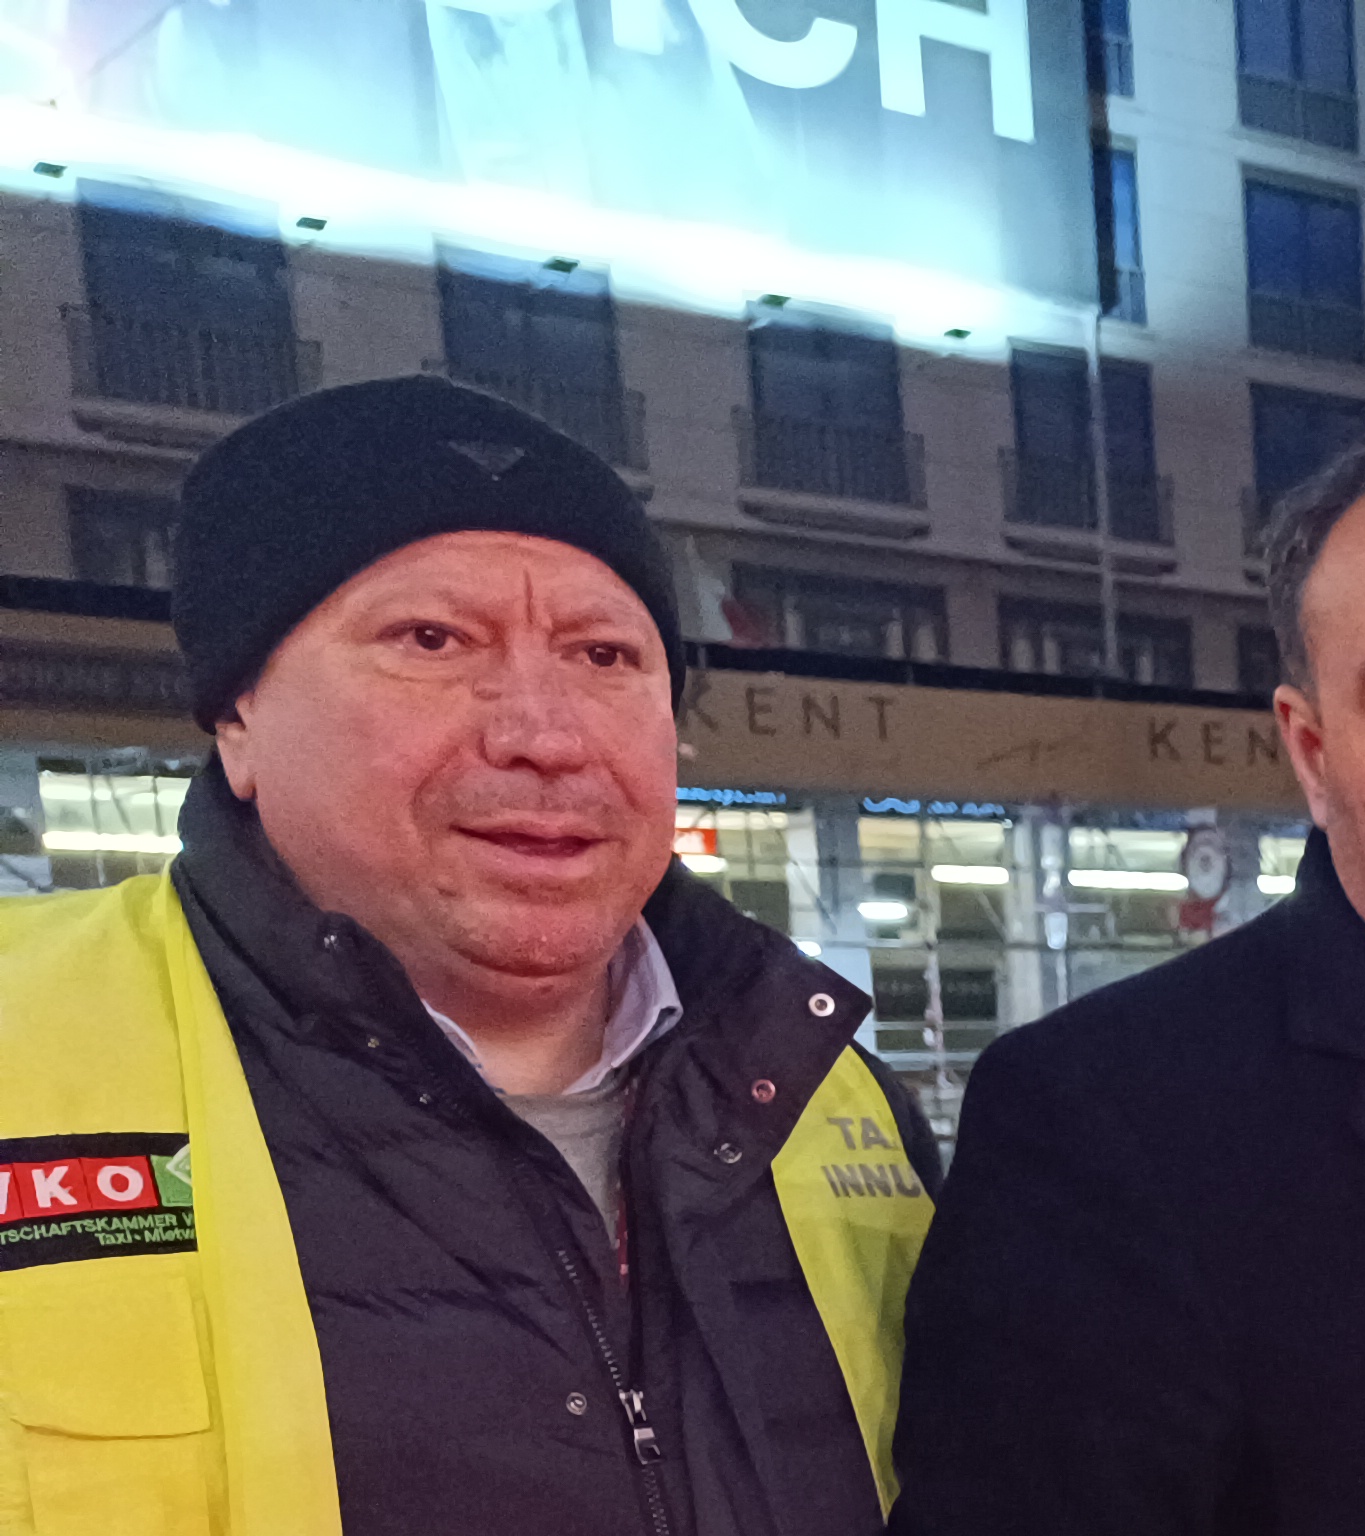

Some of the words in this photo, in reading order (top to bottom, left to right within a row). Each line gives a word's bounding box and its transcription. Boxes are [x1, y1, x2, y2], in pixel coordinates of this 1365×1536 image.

[610, 0, 1036, 145] CH
[677, 668, 896, 742] KENT
[94, 1229, 132, 1246] Taxi
